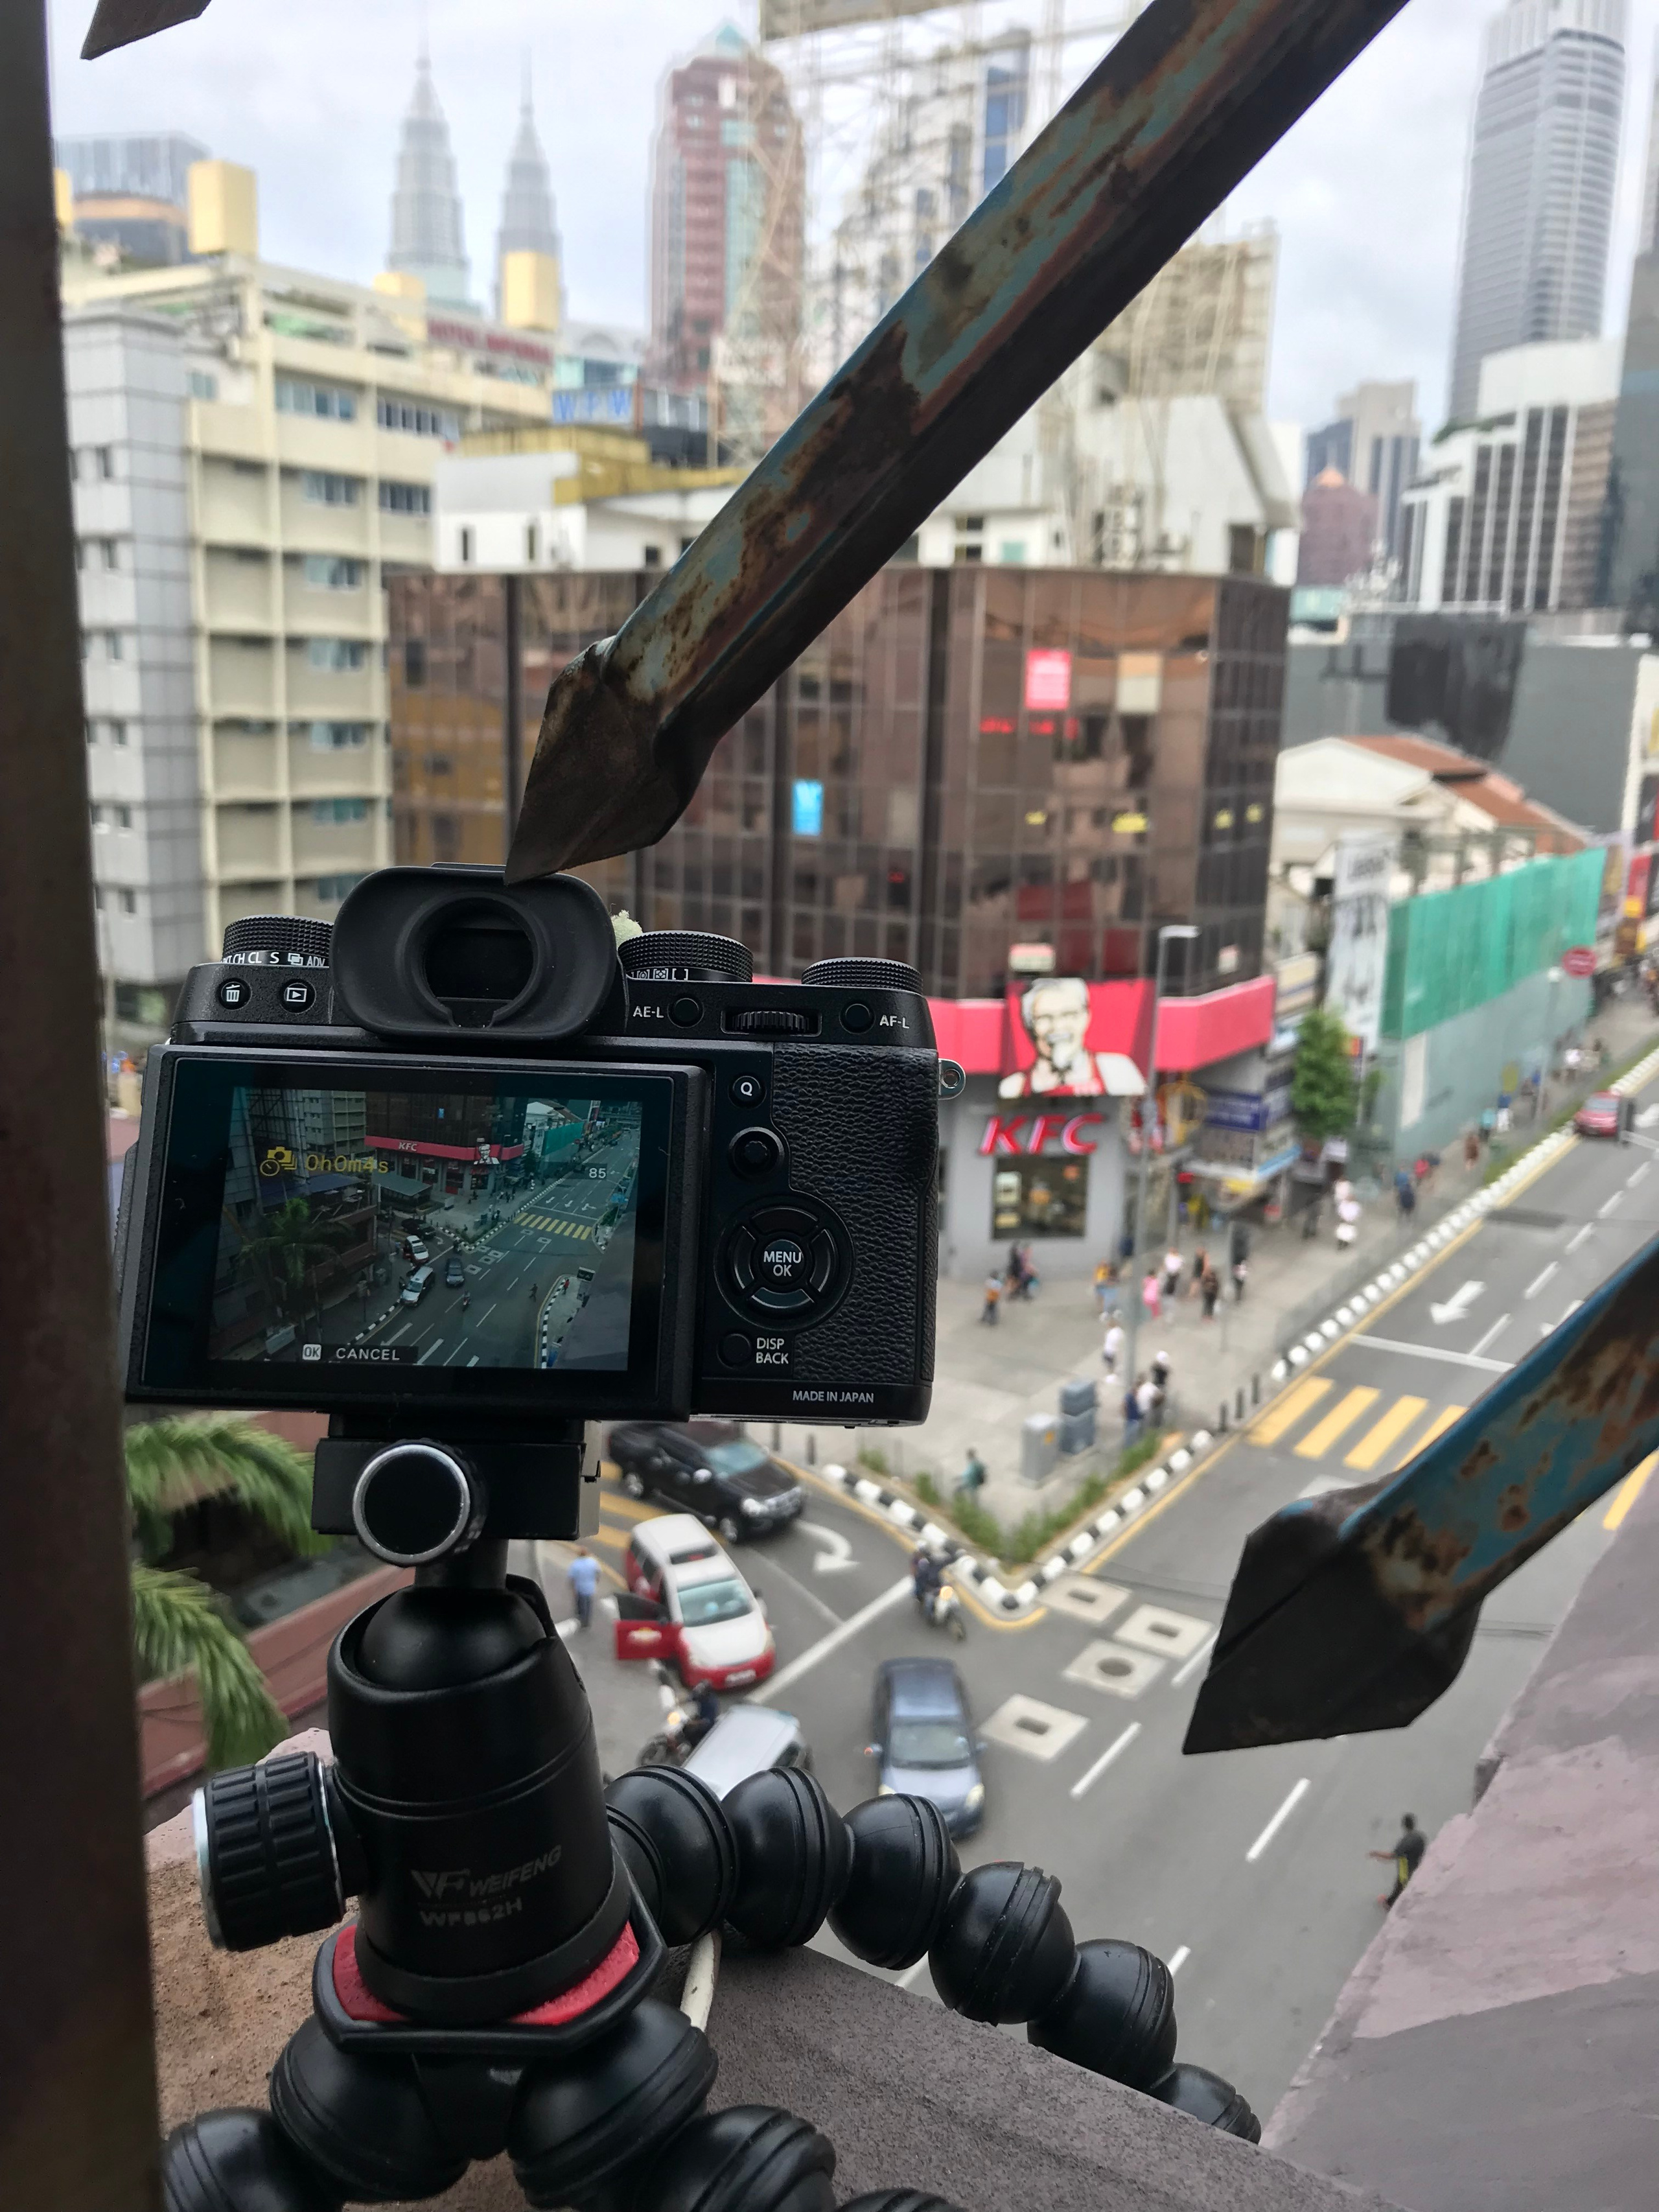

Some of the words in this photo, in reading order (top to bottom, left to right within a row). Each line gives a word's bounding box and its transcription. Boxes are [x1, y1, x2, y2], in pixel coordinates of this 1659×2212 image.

[233, 952, 246, 964] CH
[248, 951, 262, 964] CL
[270, 951, 279, 964] S
[632, 1005, 664, 1019] AE-L
[879, 1015, 910, 1029] AF-L
[740, 1082, 753, 1096] Q
[978, 1112, 1106, 1156] KFC
[398, 1141, 418, 1152] KFC
[588, 1167, 607, 1179] 85
[763, 1251, 802, 1263] MENU
[772, 1264, 792, 1277] OK
[756, 1338, 785, 1350] DISP
[303, 1346, 320, 1358] OK
[336, 1347, 400, 1360] CANCEL
[756, 1352, 789, 1364] BACK
[793, 1391, 825, 1401] MADE
[826, 1391, 837, 1401] IN
[839, 1392, 874, 1403] JAPAN
[469, 1845, 562, 1898] WEIFENG
